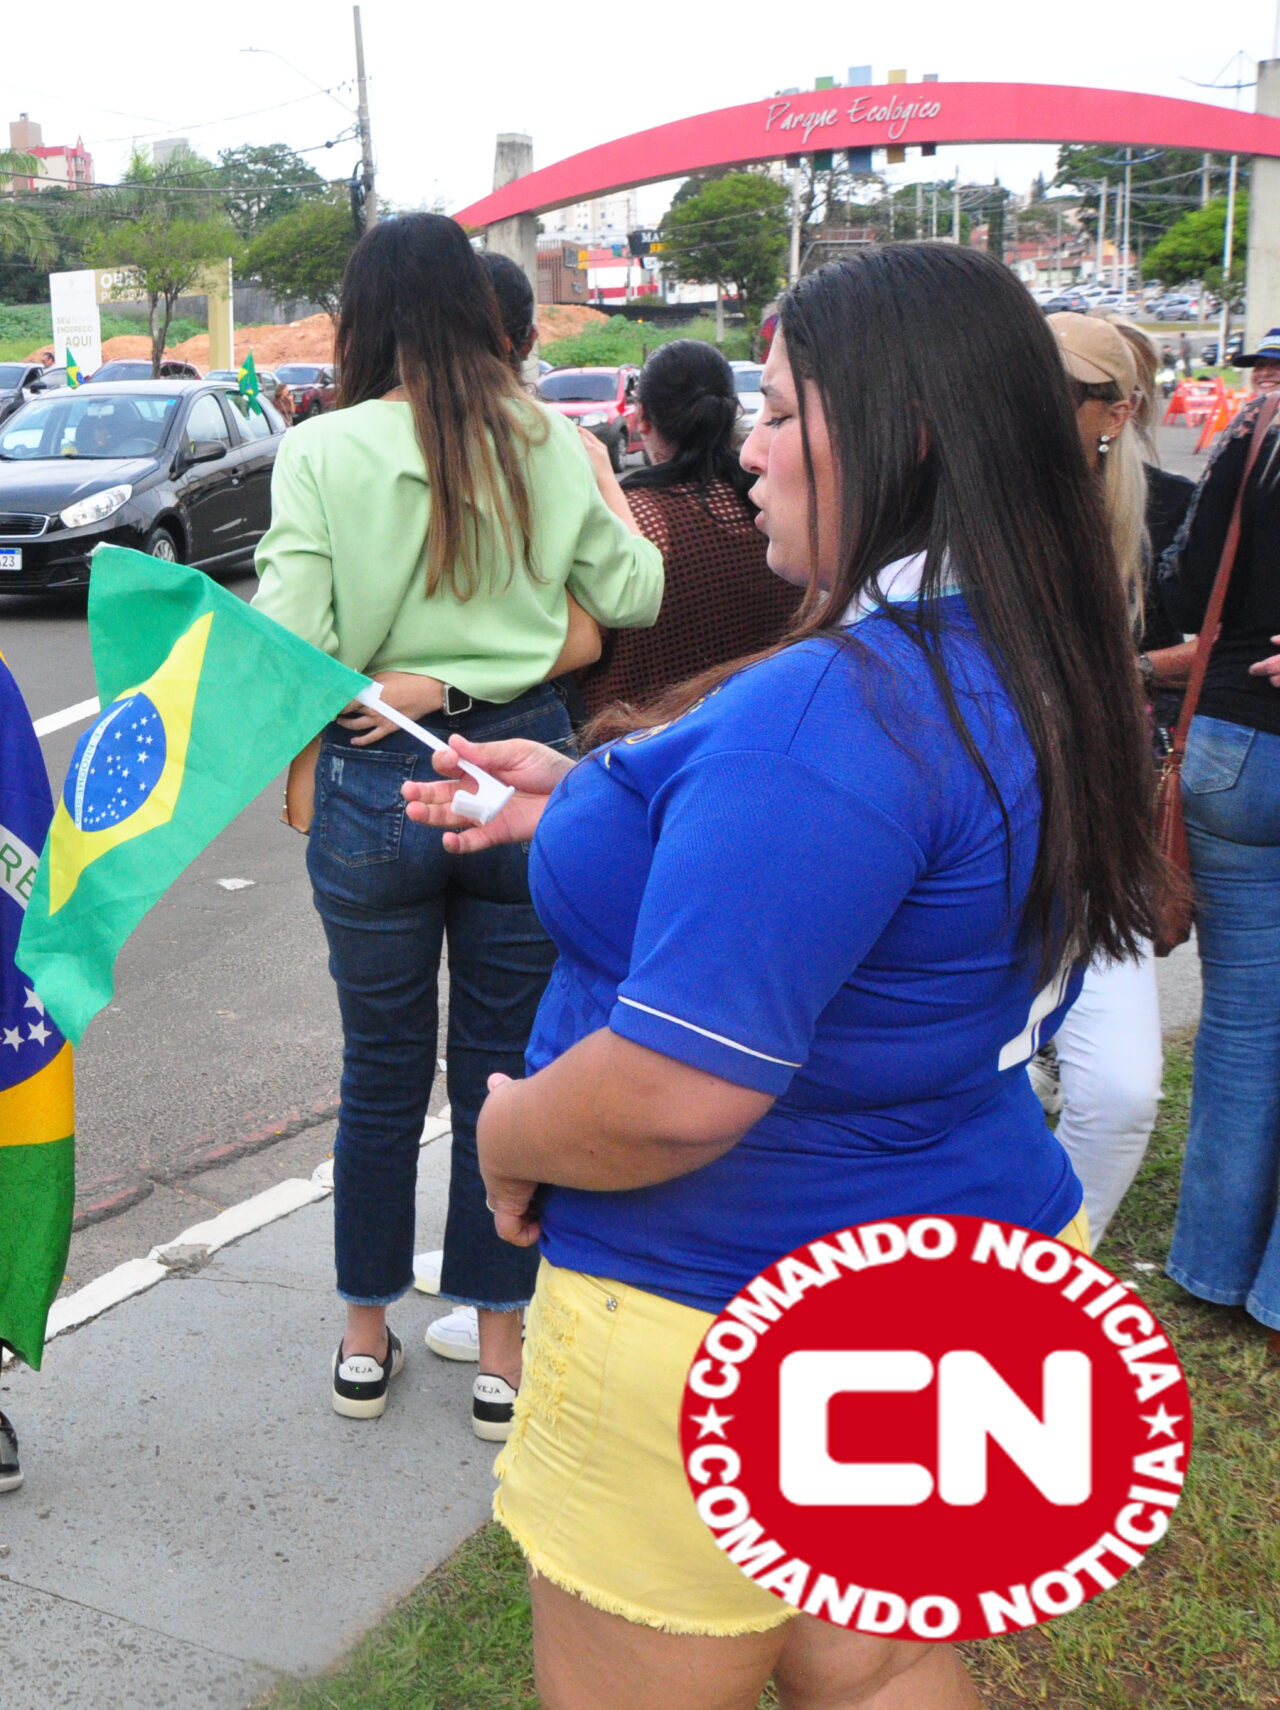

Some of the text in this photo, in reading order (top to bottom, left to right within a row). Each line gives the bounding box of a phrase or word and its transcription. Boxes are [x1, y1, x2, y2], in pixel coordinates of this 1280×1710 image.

[765, 95, 941, 144] Parque Ecológico
[66, 335, 92, 347] AQUI
[348, 1365, 373, 1374] VEJA
[476, 1384, 501, 1395] VEJA
